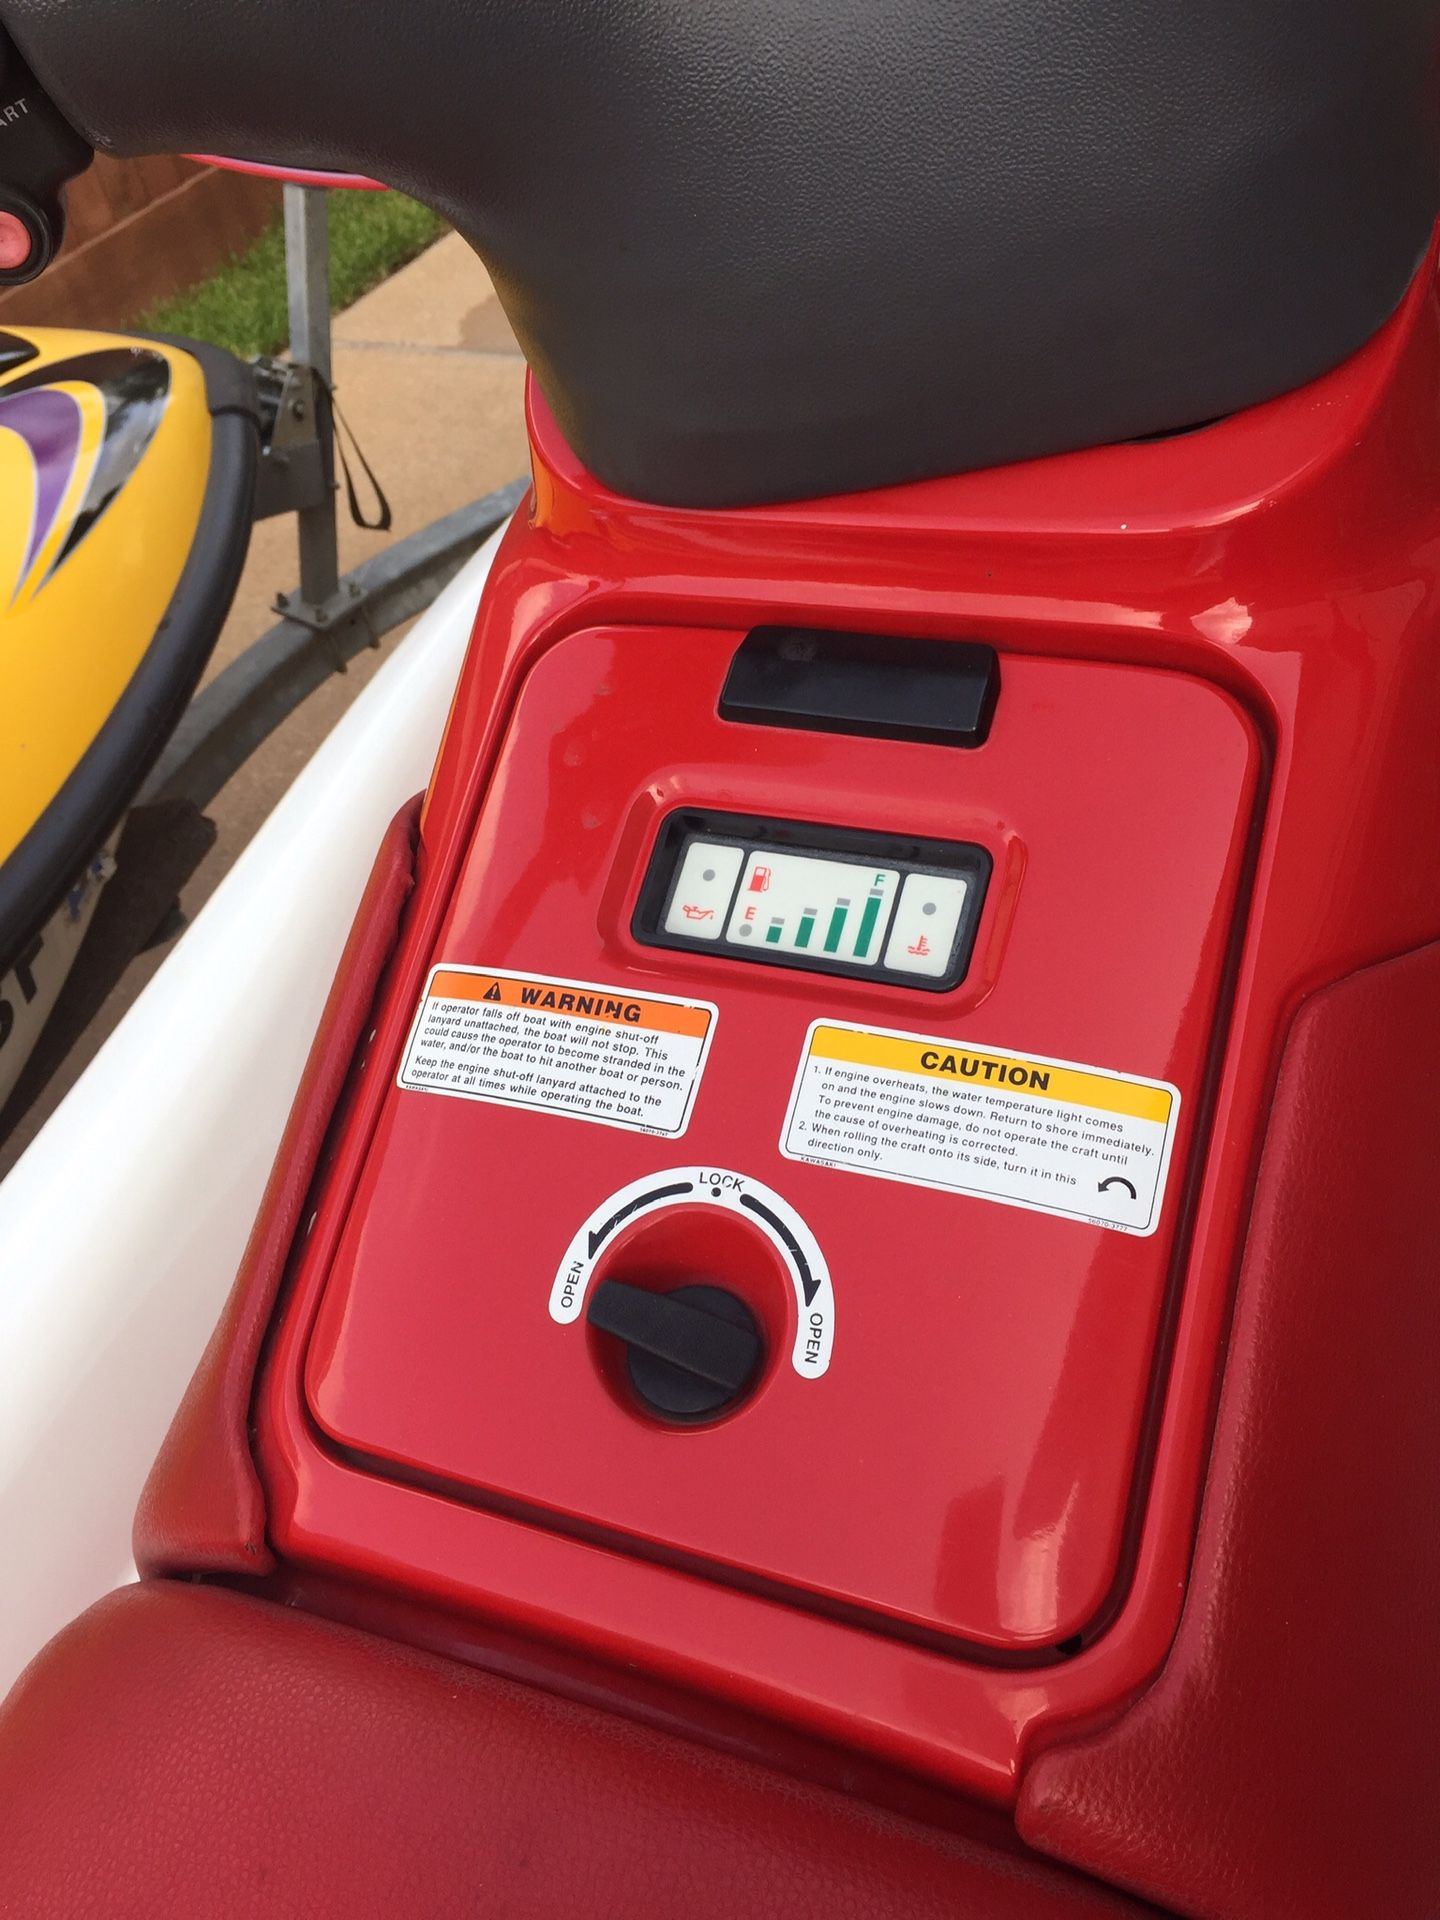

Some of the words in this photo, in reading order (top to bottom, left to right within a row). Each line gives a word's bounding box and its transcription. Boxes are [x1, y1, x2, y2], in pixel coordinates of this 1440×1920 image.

[873, 873, 887, 887] F
[745, 906, 757, 920] E
[431, 1001, 439, 1011] If
[440, 1004, 480, 1016] operator
[482, 1007, 503, 1019] falls
[505, 1011, 521, 1022] off
[522, 1013, 547, 1026] boat
[549, 1018, 572, 1030] with
[574, 1023, 612, 1037] engine
[614, 1030, 660, 1045] shut-off
[521, 987, 642, 1023] WARNING
[424, 1027, 450, 1037] could
[450, 1030, 479, 1041] cause
[480, 1033, 497, 1044] the
[498, 1037, 543, 1051] operator
[544, 1043, 556, 1054] to
[557, 1044, 600, 1062] become
[602, 1055, 652, 1072] stranded
[653, 1062, 665, 1074] in
[667, 1065, 686, 1078] the
[427, 1014, 463, 1026] lanyard
[463, 1019, 520, 1036] unattached,
[523, 1026, 541, 1038] the
[543, 1029, 568, 1043] boat
[570, 1035, 589, 1046] will
[590, 1039, 610, 1050] not
[611, 1043, 639, 1057] stop.
[645, 1046, 669, 1061] This
[414, 1055, 438, 1069] Keep
[440, 1059, 456, 1070] the
[457, 1063, 490, 1075] engine
[492, 1067, 535, 1083] shut-off
[535, 1074, 577, 1091] lanyard
[578, 1083, 627, 1100] attached
[629, 1091, 641, 1103] to
[643, 1094, 662, 1107] the
[420, 1039, 447, 1050] water,
[448, 1042, 481, 1054] and/or
[482, 1045, 499, 1057] the
[500, 1048, 524, 1062] boat
[525, 1053, 537, 1064] to
[538, 1055, 554, 1067] hit
[554, 1060, 598, 1075] another
[598, 1065, 624, 1080] boat
[626, 1073, 639, 1083] or
[639, 1075, 683, 1091] person.
[920, 1051, 1051, 1091] CAUTION
[411, 1069, 450, 1081] operator
[451, 1074, 462, 1084] at
[463, 1075, 477, 1086] all
[478, 1077, 506, 1091] times
[509, 1084, 538, 1097] while
[540, 1090, 592, 1109] operating
[595, 1099, 613, 1111] the
[616, 1102, 644, 1117] boat.
[814, 1065, 821, 1074] 1.
[824, 1066, 833, 1076] If
[834, 1070, 870, 1083] engine
[872, 1076, 928, 1094] overheats,
[931, 1086, 949, 1097] the
[952, 1090, 983, 1103] water
[985, 1095, 1054, 1117] temperature
[1056, 1109, 1083, 1123] light
[1085, 1117, 1124, 1133] comes
[814, 1109, 832, 1120] the
[833, 1114, 866, 1127] cause
[867, 1119, 880, 1129] of
[881, 1122, 946, 1145] overheating
[948, 1134, 959, 1145] is
[961, 1138, 1018, 1157] corrected.
[818, 1094, 832, 1105] To
[833, 1099, 875, 1113] prevent
[876, 1106, 914, 1121] engine
[915, 1113, 962, 1131] damage,
[965, 1122, 980, 1134] do
[982, 1127, 1002, 1138] not
[1003, 1131, 1048, 1147] operate
[1050, 1140, 1069, 1152] the
[1071, 1146, 1099, 1159] craft
[1101, 1152, 1128, 1166] until
[821, 1082, 835, 1091] on
[837, 1085, 858, 1096] and
[859, 1087, 877, 1099] the
[879, 1092, 916, 1106] engine
[918, 1099, 950, 1112] slows
[952, 1104, 986, 1119] down.
[989, 1110, 1028, 1127] Return
[1031, 1119, 1043, 1131] to
[1045, 1123, 1079, 1138] shore
[1081, 1130, 1155, 1157] immediately.
[798, 1120, 807, 1131] 2.
[812, 1122, 841, 1137] When
[843, 1131, 878, 1146] rolling
[880, 1136, 898, 1148] the
[900, 1142, 926, 1154] craft
[928, 1147, 954, 1159] onto
[956, 1152, 971, 1162] its
[973, 1155, 1000, 1170] side,
[1003, 1161, 1027, 1174] turn
[1030, 1168, 1038, 1177] it
[1040, 1168, 1052, 1180] in
[1055, 1172, 1077, 1186] this
[807, 1137, 855, 1155] direction
[857, 1148, 883, 1162] only.
[699, 1171, 745, 1192] LOCK
[561, 1261, 585, 1308] OPEN
[804, 1313, 823, 1364] OPEN
